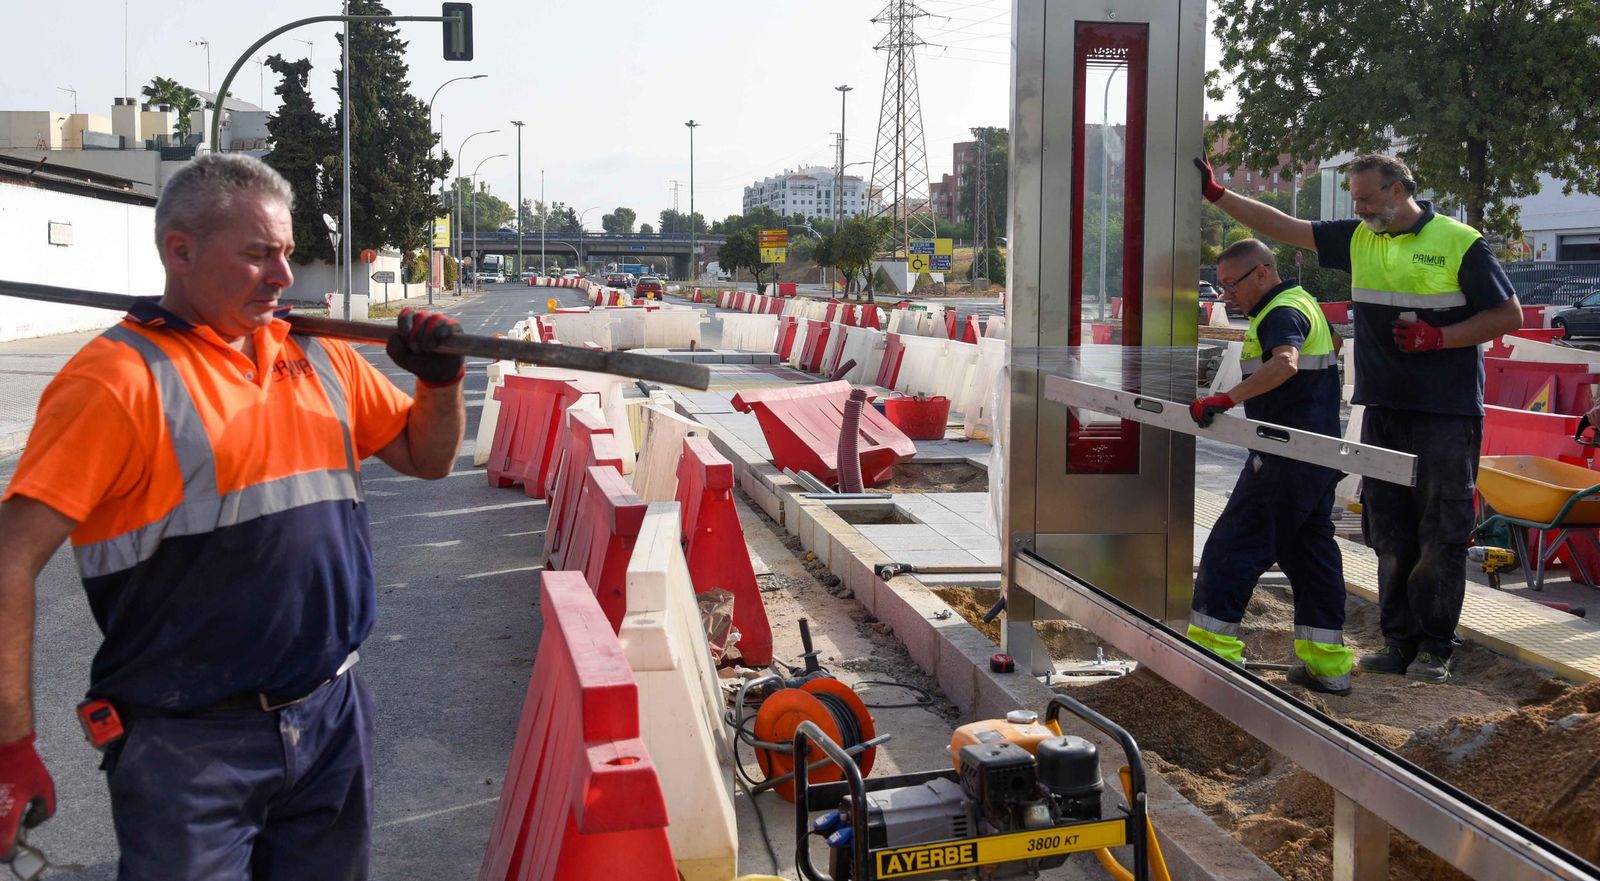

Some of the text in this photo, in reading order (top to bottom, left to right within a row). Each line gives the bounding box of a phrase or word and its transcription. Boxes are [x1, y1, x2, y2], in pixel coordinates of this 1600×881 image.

[1412, 253, 1446, 266] PRIMUR
[887, 834, 1080, 874] AYERBE 3800 KT
